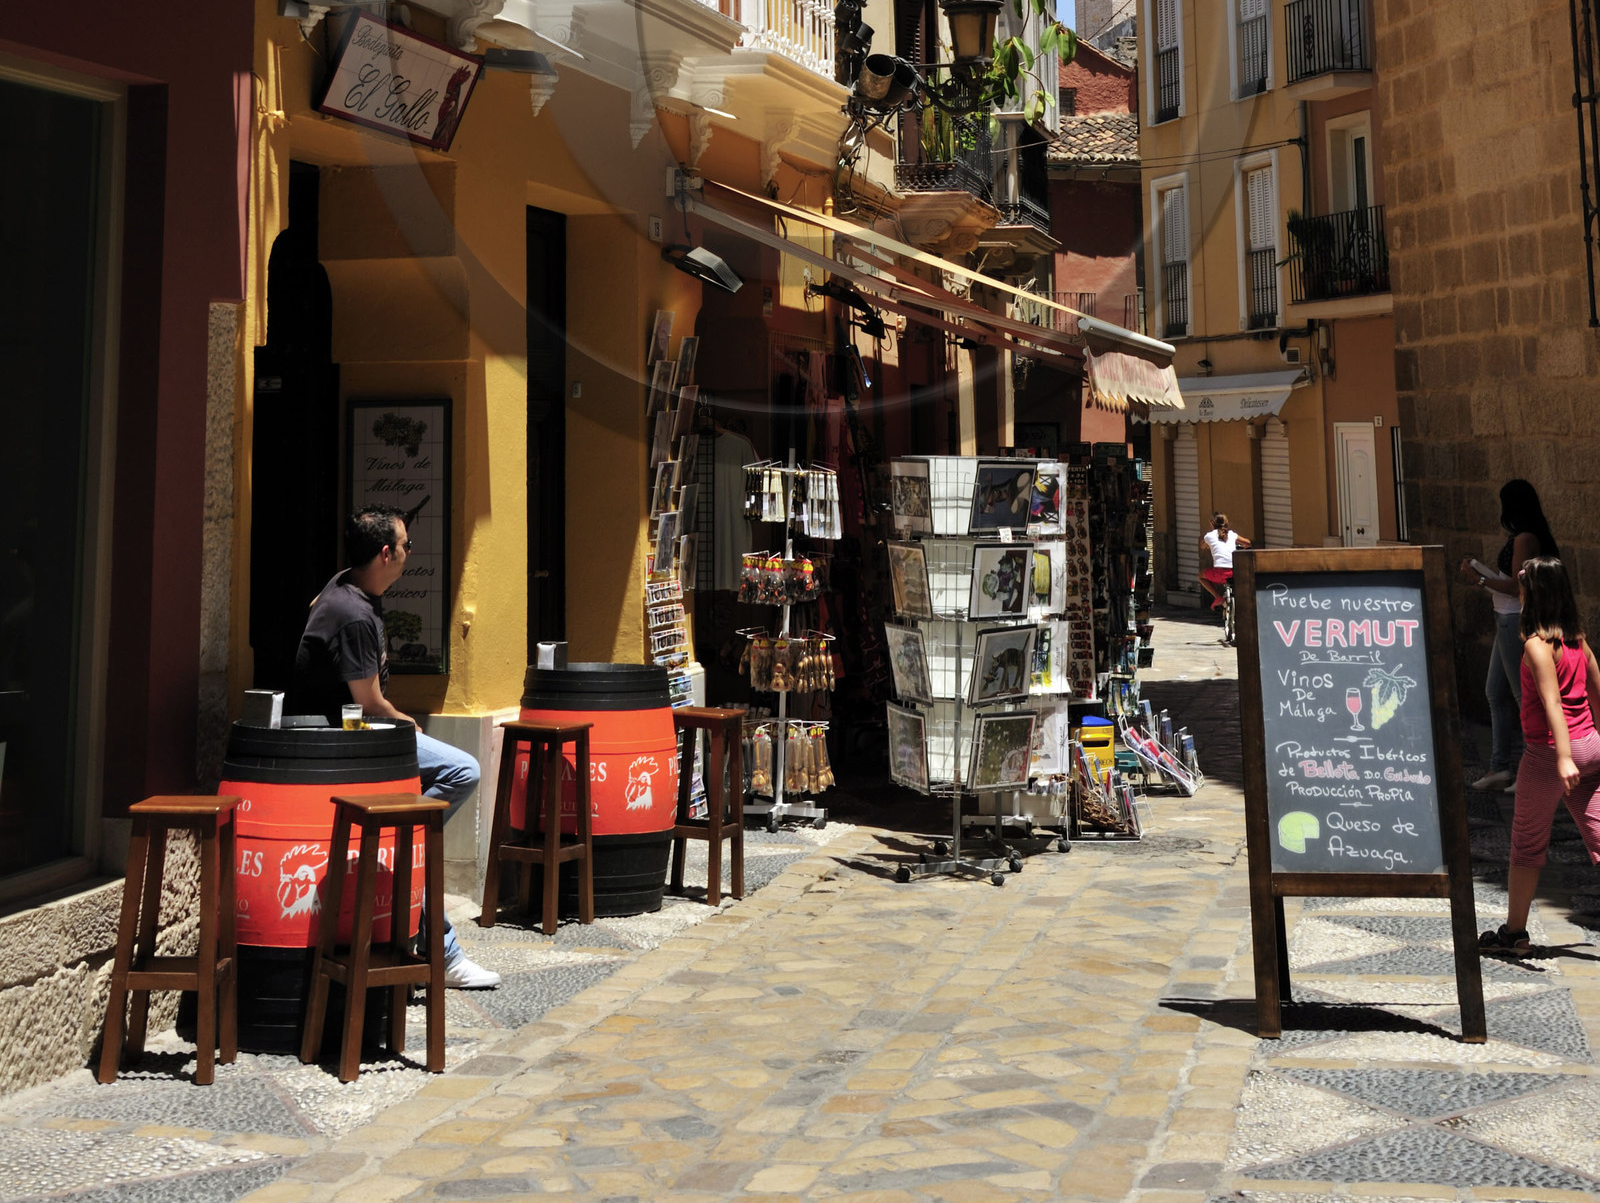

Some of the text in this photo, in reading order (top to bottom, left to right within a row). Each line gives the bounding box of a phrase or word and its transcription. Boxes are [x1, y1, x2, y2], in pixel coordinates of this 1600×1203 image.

[344, 63, 439, 131] El Gallo
[365, 458, 432, 471] Vinos de
[365, 477, 427, 496] Málaga
[381, 586, 428, 599] bericos
[1266, 583, 1414, 613] Pruebe nuestro
[1273, 618, 1419, 647] VERMUT
[1299, 650, 1381, 663] De Barril
[1278, 669, 1334, 689] Vinos
[1292, 688, 1316, 701] De
[1279, 700, 1337, 722] Málaga
[1275, 740, 1427, 763] Productos Ibéricos
[1278, 762, 1296, 777] de
[1298, 759, 1360, 781] Bellota
[1326, 811, 1419, 837] Queso de
